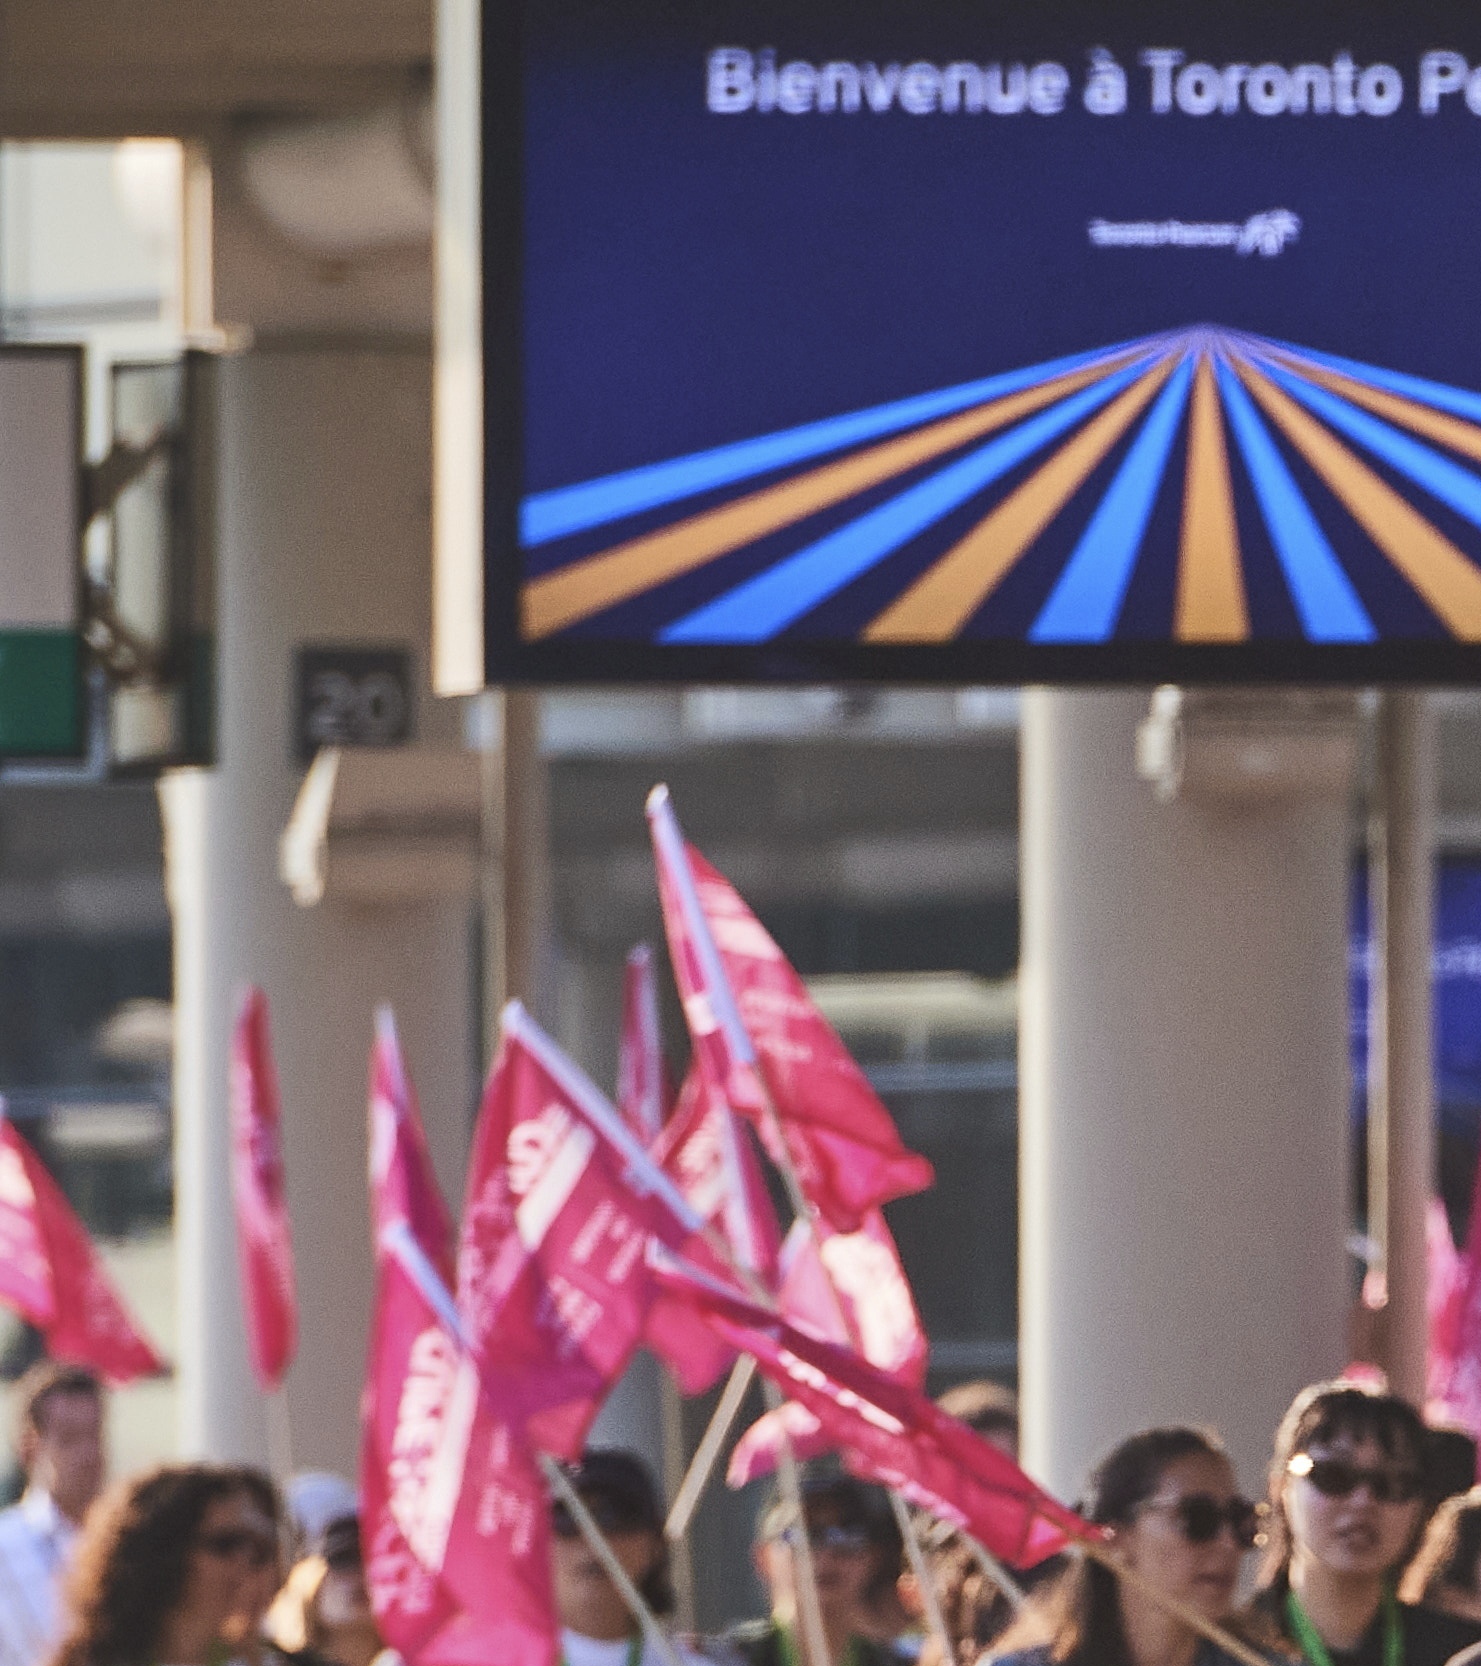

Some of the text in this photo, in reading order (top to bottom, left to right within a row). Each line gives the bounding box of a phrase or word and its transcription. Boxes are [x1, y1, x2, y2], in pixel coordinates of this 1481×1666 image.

[706, 46, 1071, 115] Bienvenue
[1082, 47, 1129, 116] à
[1137, 47, 1402, 117] Toronto
